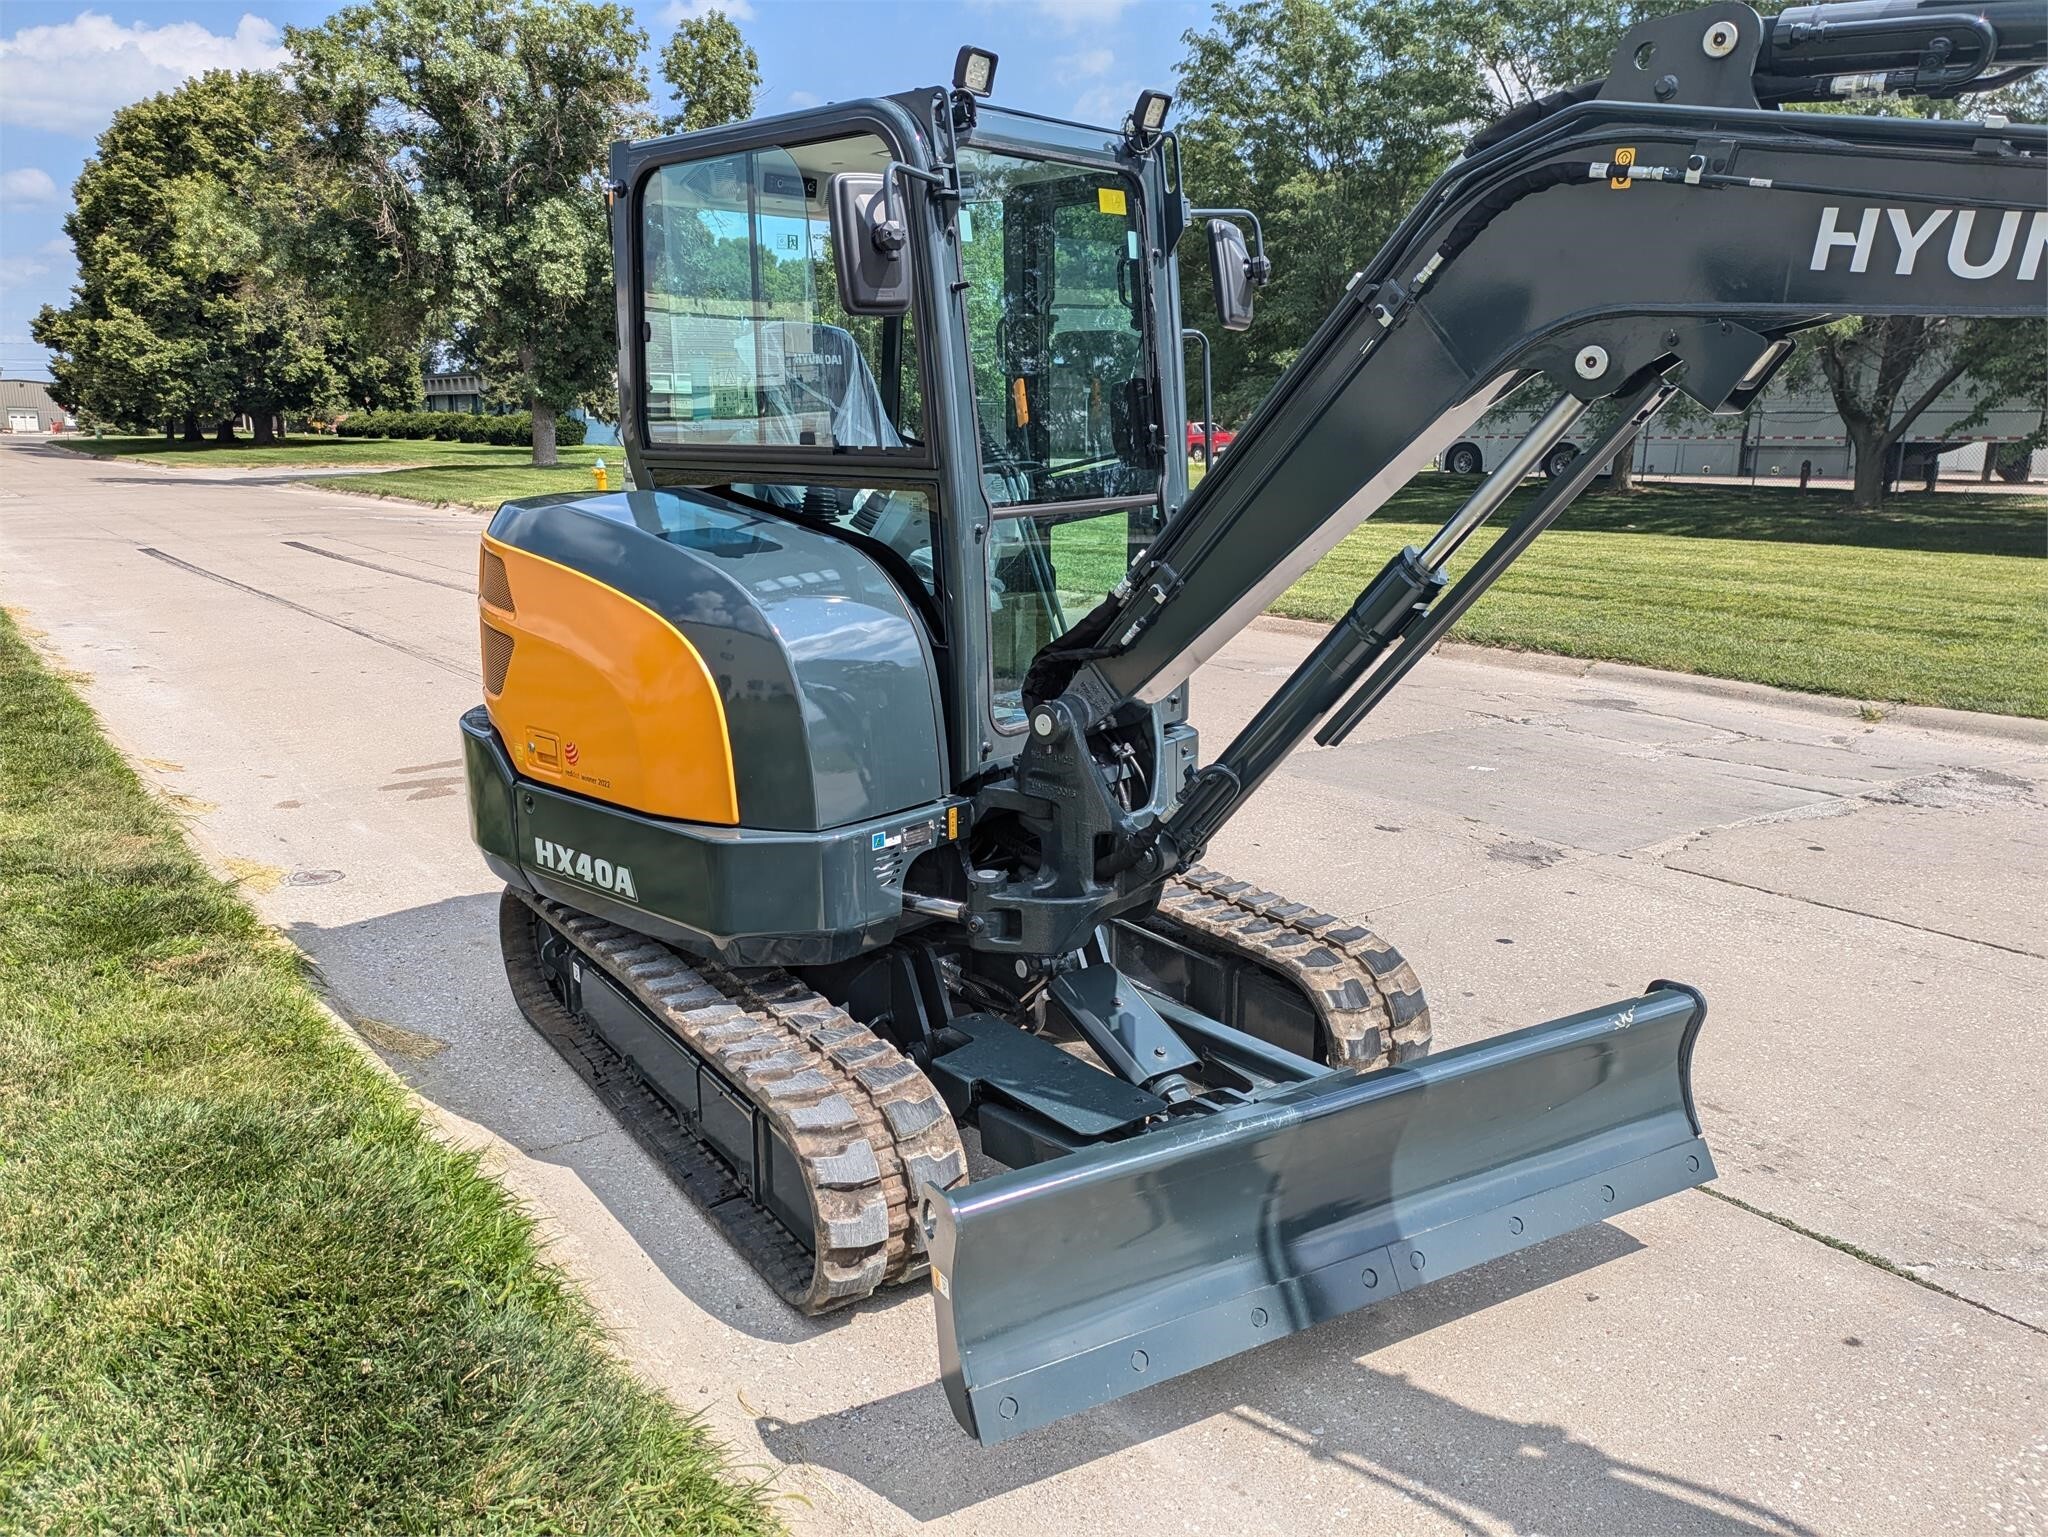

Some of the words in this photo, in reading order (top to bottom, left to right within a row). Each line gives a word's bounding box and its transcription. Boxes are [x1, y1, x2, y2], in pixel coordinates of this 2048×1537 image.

[793, 353, 842, 365] HYUNDAI
[581, 774, 597, 784] winner
[597, 778, 610, 788] 2022
[535, 837, 635, 898] HX40A
